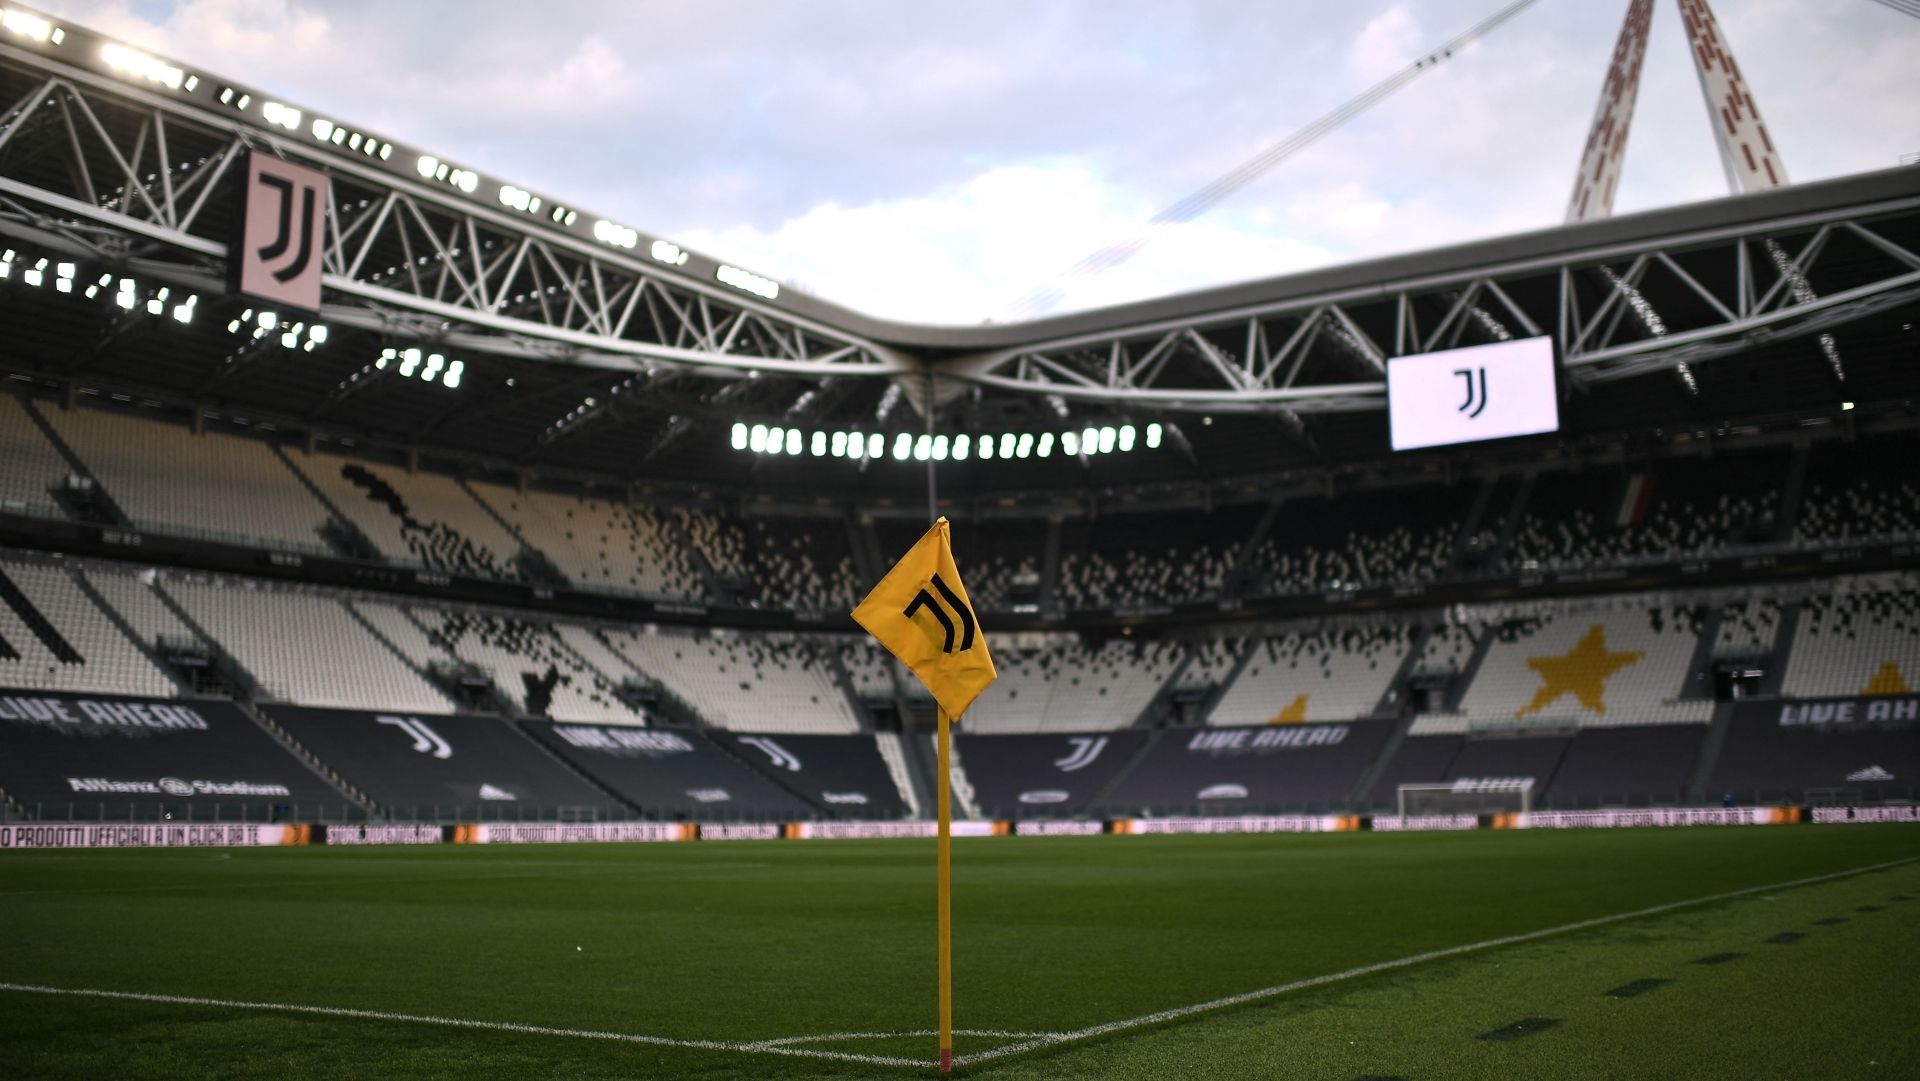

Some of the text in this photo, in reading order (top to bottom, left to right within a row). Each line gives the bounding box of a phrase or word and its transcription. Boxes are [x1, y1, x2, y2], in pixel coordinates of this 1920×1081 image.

[77, 700, 208, 730] AHEAD
[1779, 702, 1856, 726] LIVE
[1188, 725, 1349, 750] LIVE AHEAD
[67, 777, 290, 796] Allianz Stadium
[16, 827, 85, 846] PRODOTTI
[89, 826, 151, 846] UFFICIALI
[154, 826, 163, 846] A
[167, 826, 185, 846] UN
[188, 826, 224, 846] CLICK
[228, 826, 244, 846] DA
[247, 826, 258, 846] TE
